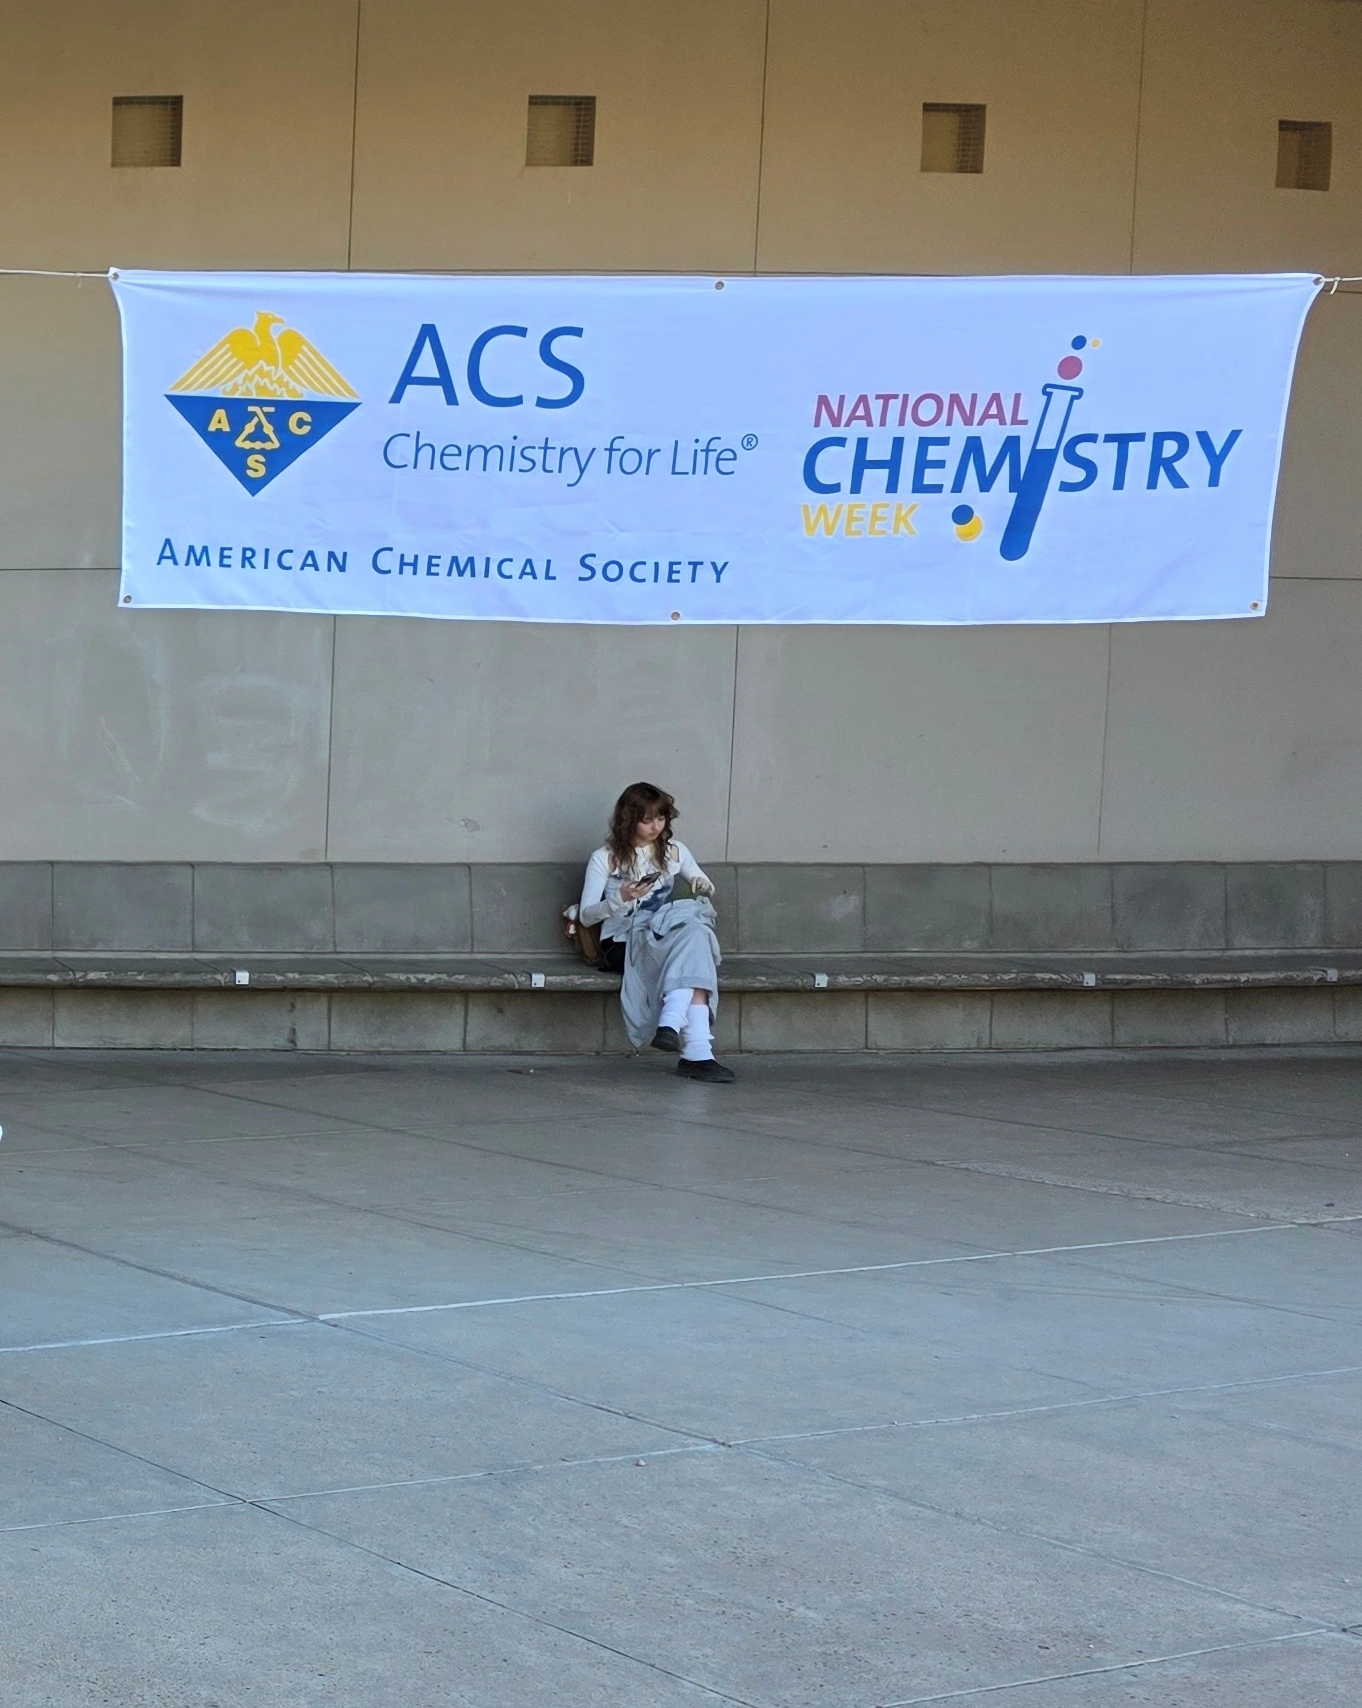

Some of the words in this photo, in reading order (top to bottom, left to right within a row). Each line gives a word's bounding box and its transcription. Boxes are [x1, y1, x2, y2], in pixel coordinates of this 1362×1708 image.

[388, 323, 585, 409] ACS
[208, 408, 231, 432] A
[288, 411, 311, 436] C
[813, 391, 1029, 428] NATIONAL
[246, 454, 267, 478] S
[382, 431, 596, 487] Chemistry
[604, 434, 660, 476] for
[802, 502, 919, 537] WEEK
[156, 537, 348, 573] AMERICAN
[371, 546, 557, 581] CHEMICAL
[578, 553, 730, 584] SOCIETY
